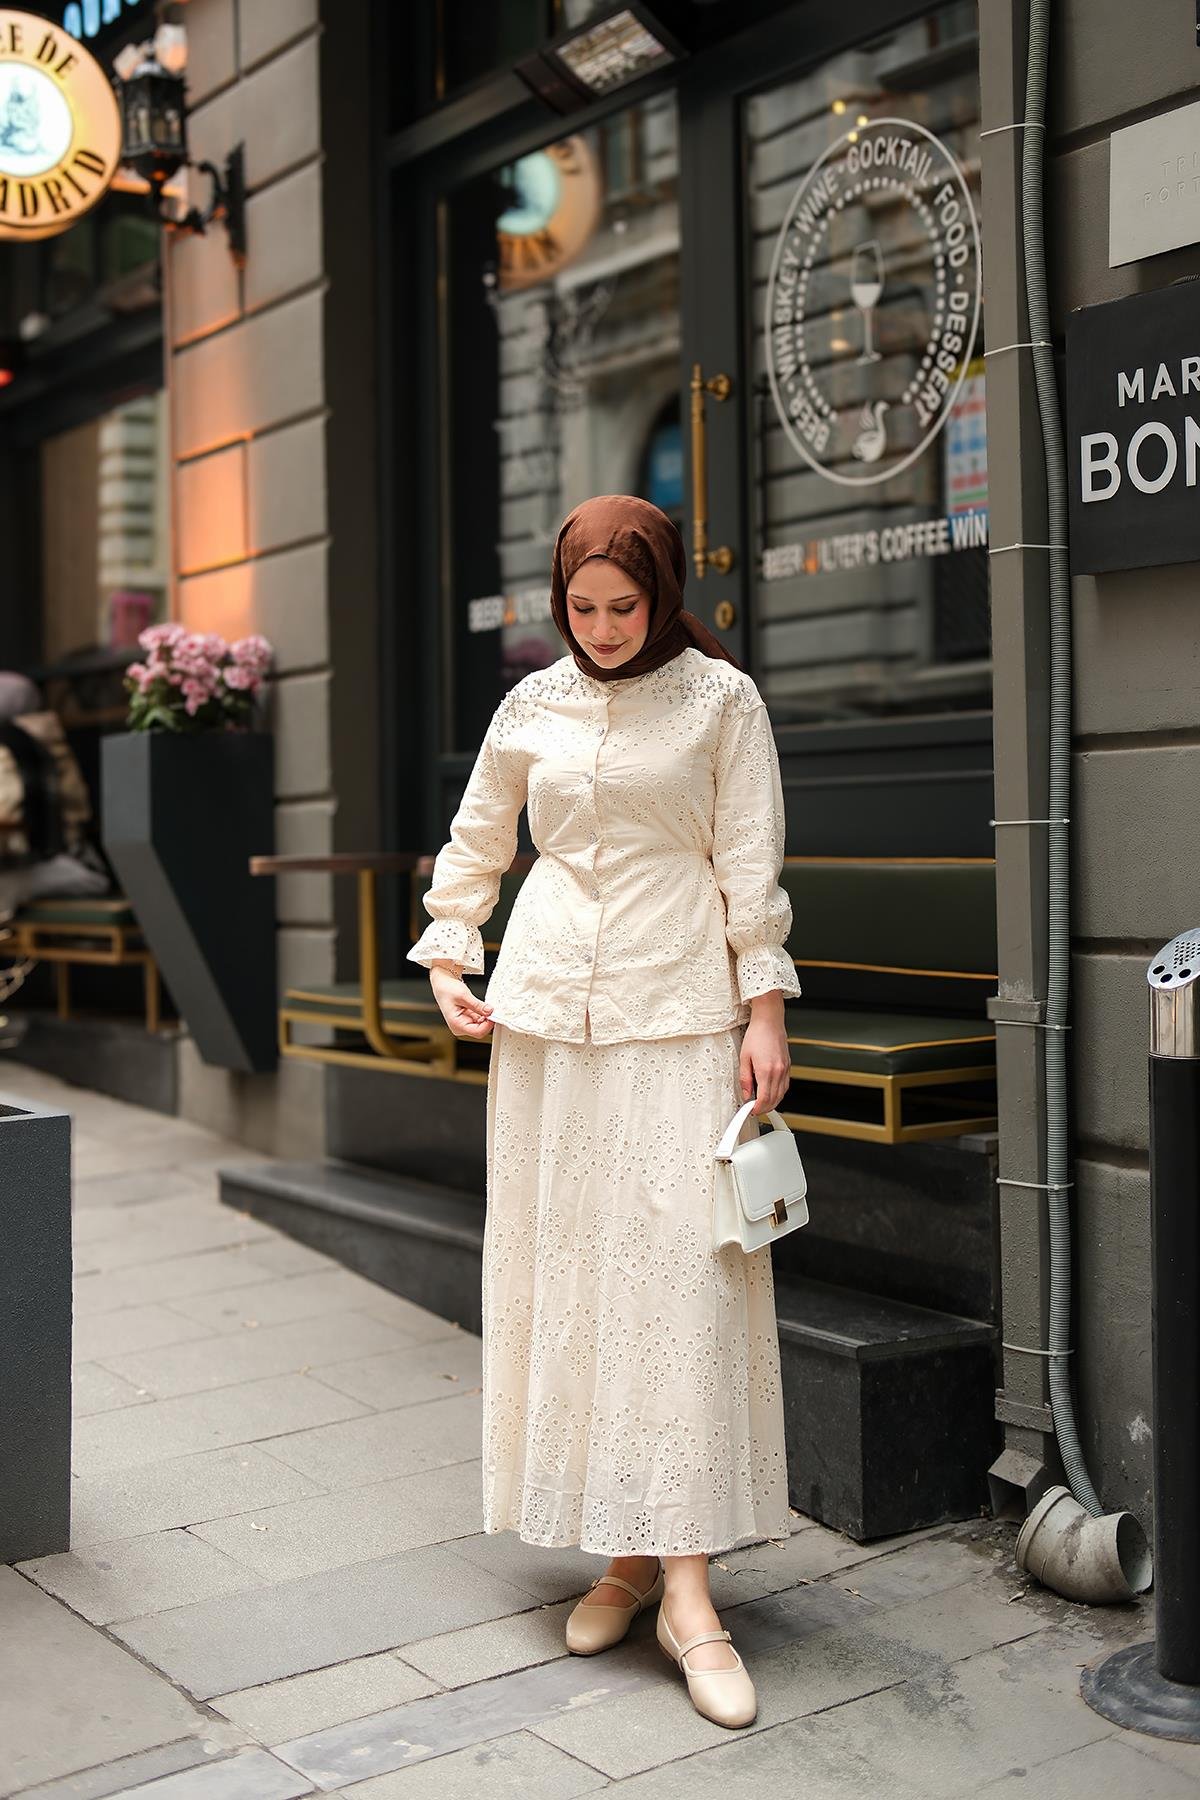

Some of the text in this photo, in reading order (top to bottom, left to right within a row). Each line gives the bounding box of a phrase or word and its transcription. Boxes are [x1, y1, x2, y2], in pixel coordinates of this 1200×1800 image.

[36, 32, 79, 79] DE
[774, 136, 969, 453] BEER WHISKEY WINE COCKTAIL FOOD DESSERT
[880, 518, 950, 560] COFFEE
